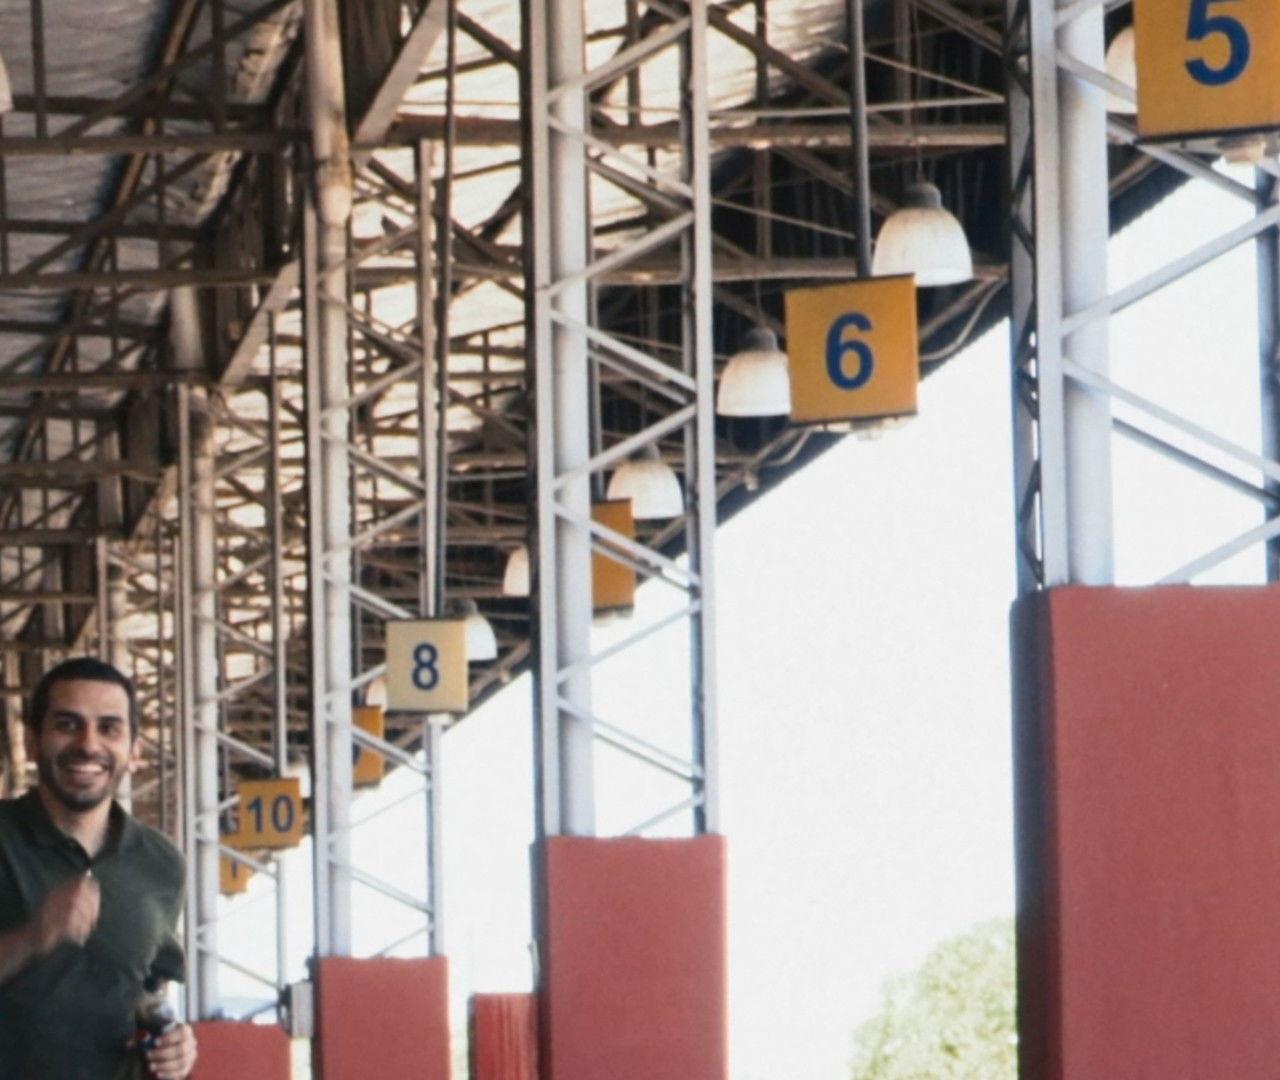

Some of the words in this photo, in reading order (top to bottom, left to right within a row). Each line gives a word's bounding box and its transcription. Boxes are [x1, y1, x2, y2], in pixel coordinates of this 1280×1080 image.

[1184, 0, 1251, 87] 5
[825, 312, 874, 390] 6
[412, 642, 439, 691] 8
[248, 795, 295, 833] 10
